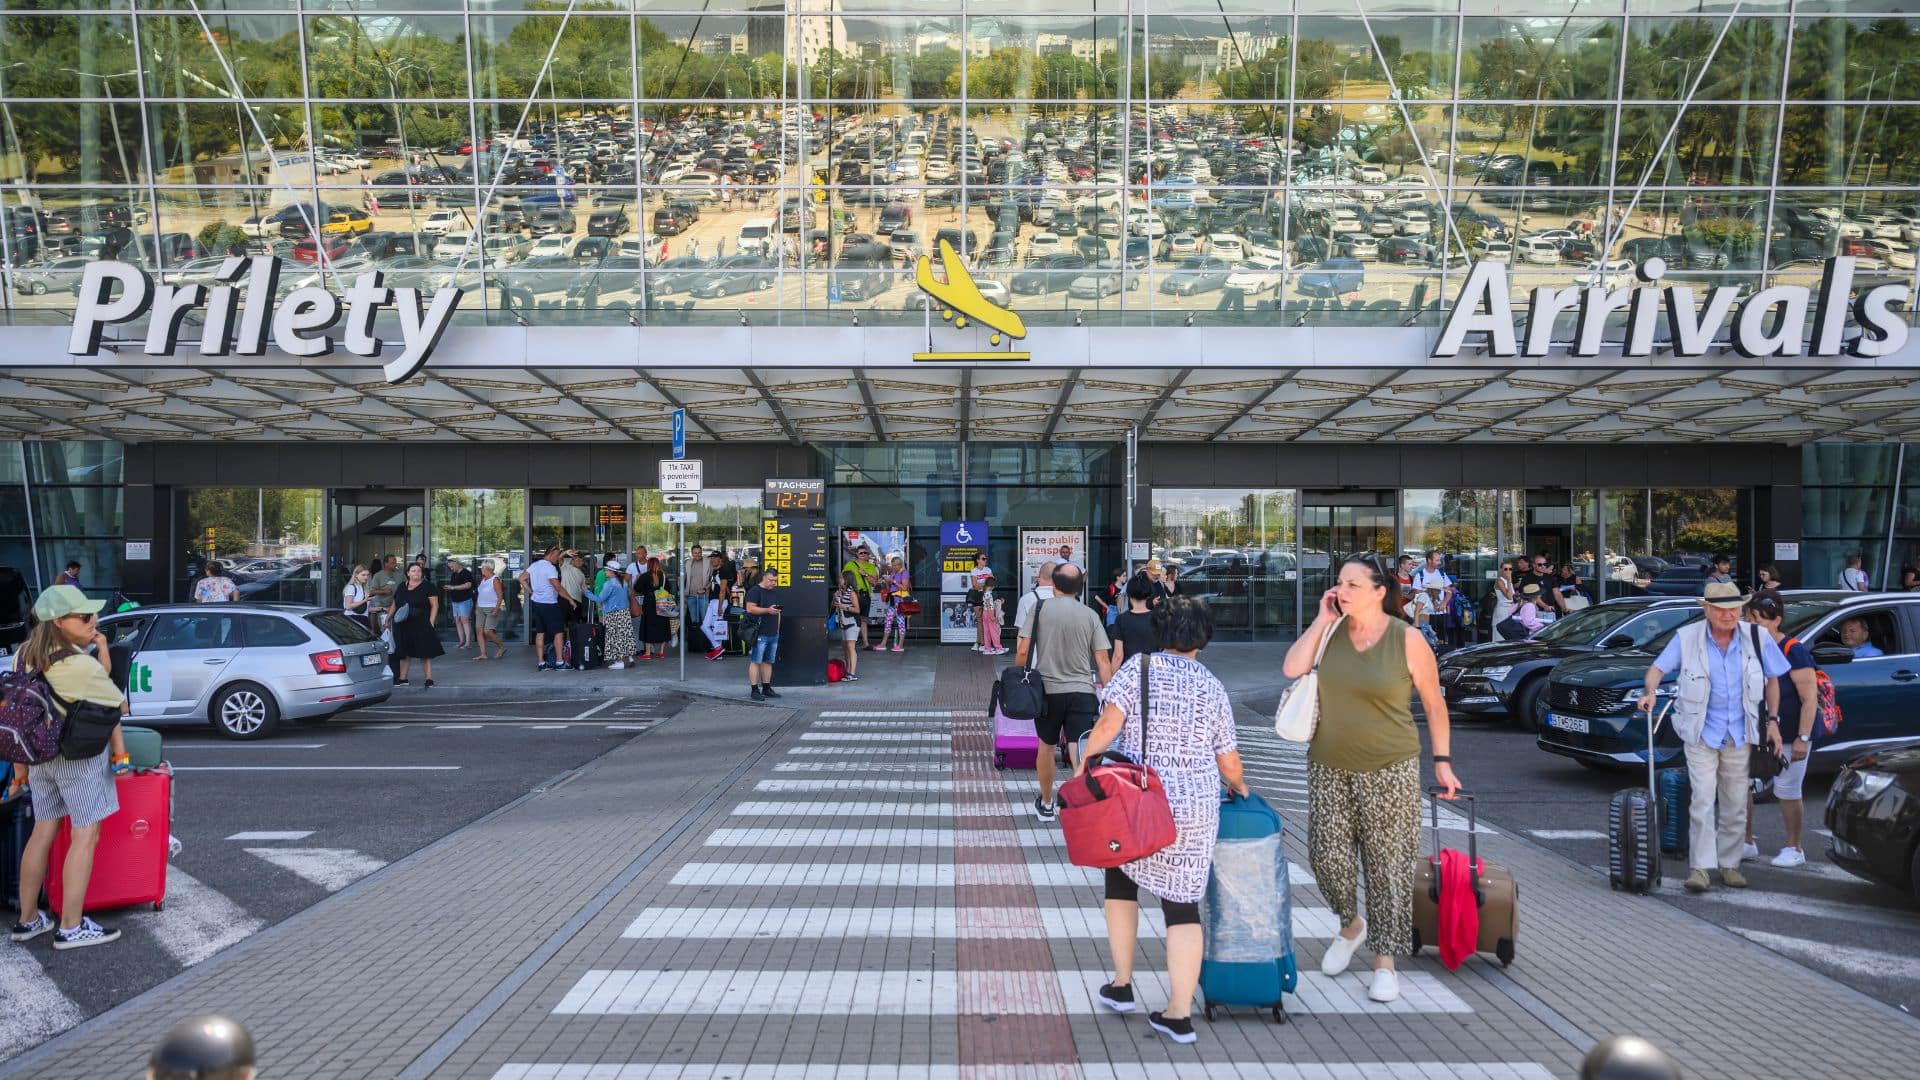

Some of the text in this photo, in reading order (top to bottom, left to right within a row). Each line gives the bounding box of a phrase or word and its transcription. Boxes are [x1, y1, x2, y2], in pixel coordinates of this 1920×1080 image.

[1432, 256, 1909, 358] Arrivals
[69, 255, 462, 383] Prílety
[776, 492, 820, 508] 12:21
[1026, 535, 1080, 546] free public
[1026, 546, 1073, 556] transpt
[1192, 682, 1207, 744] VITAMINS
[1147, 724, 1179, 734] OCTOR
[1180, 706, 1189, 747] MEDICAL
[1146, 742, 1178, 754] EART
[1168, 781, 1176, 796] DIET
[1177, 770, 1187, 797] WATER
